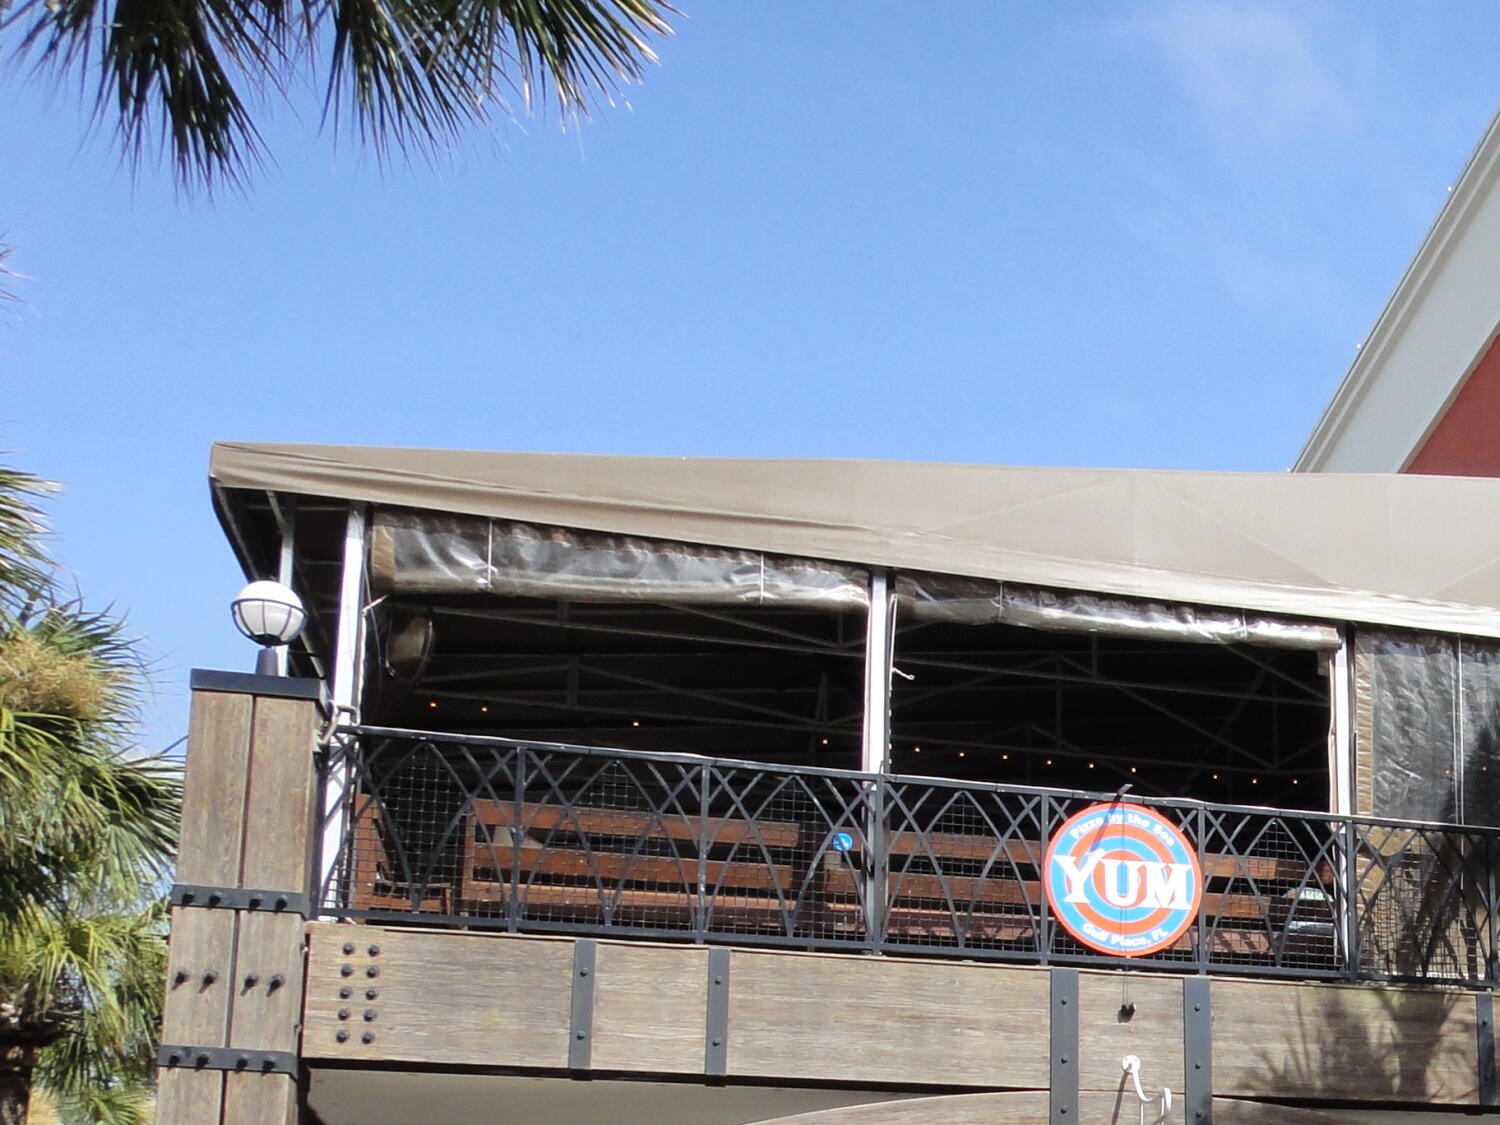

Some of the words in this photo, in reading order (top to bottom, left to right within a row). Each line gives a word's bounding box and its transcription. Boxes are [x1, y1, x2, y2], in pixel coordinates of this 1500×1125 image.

[1127, 813, 1151, 828] the
[1152, 823, 1176, 847] Sea
[1052, 848, 1194, 912] YUM
[1082, 922, 1110, 943] Gulf
